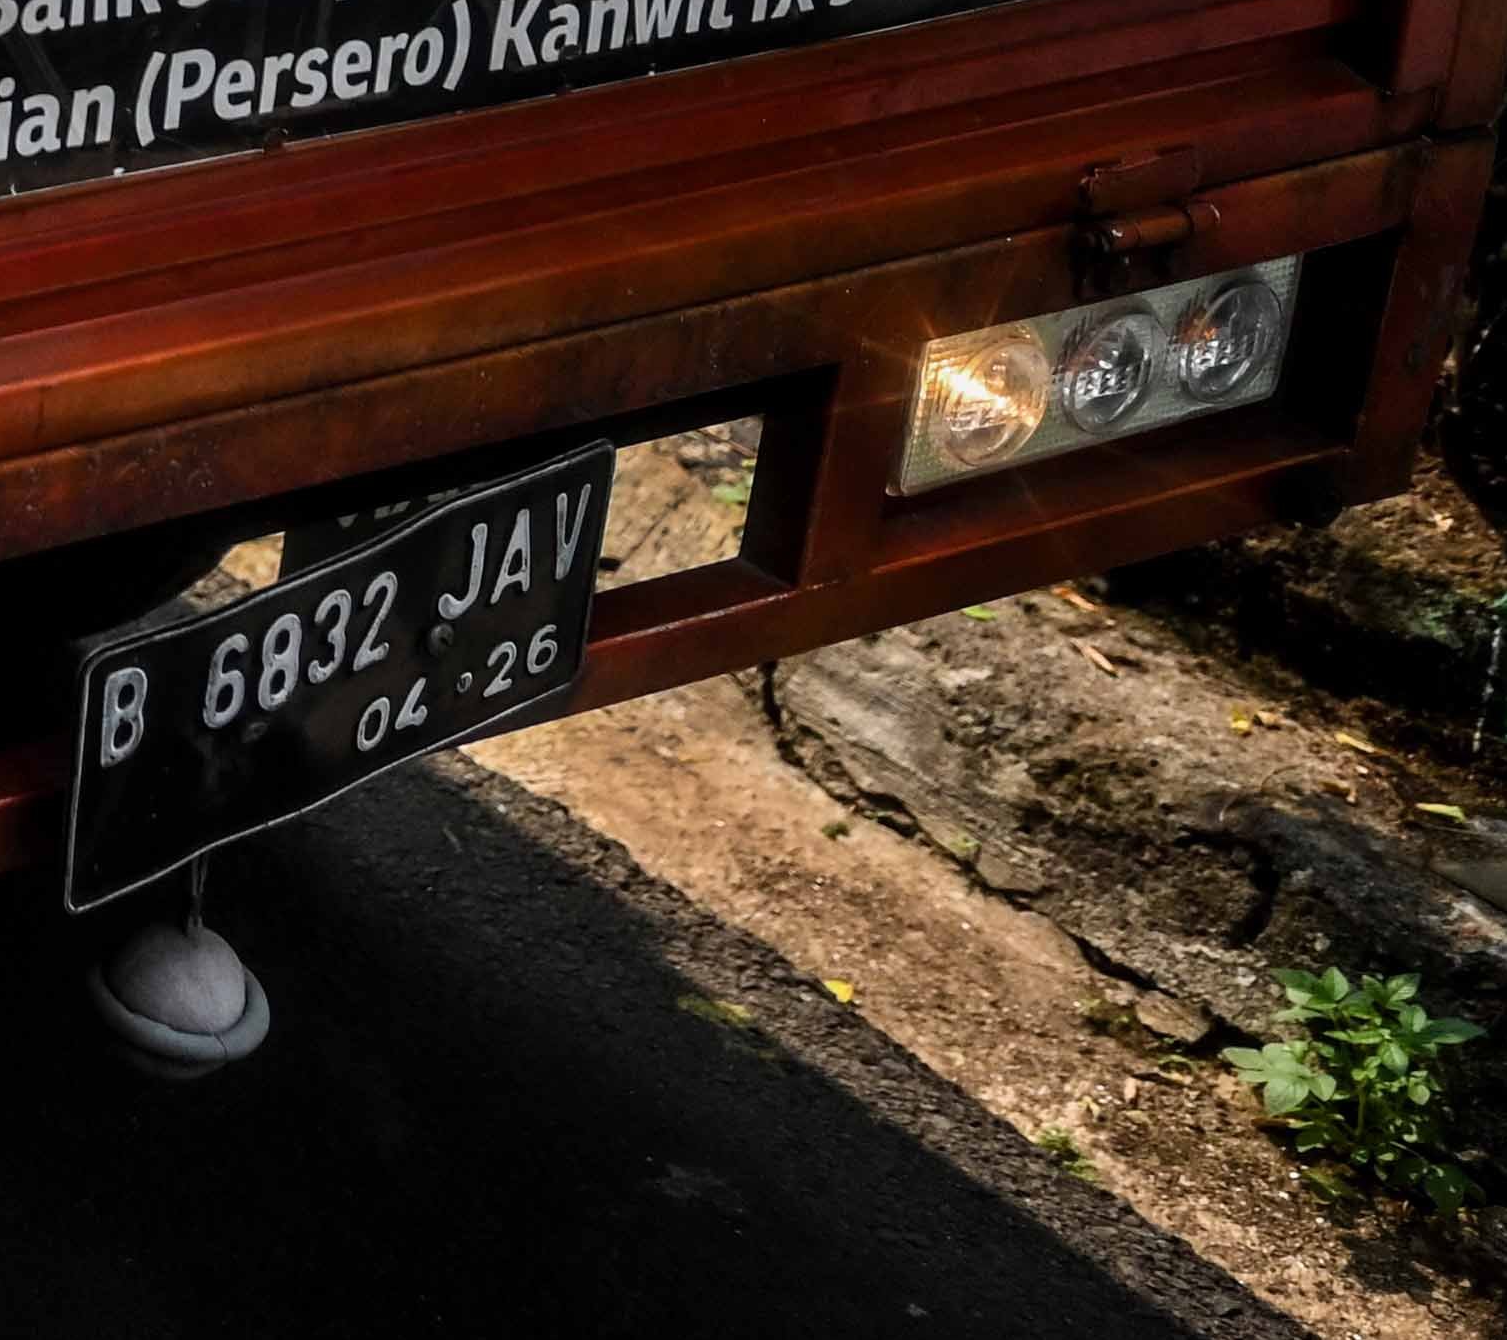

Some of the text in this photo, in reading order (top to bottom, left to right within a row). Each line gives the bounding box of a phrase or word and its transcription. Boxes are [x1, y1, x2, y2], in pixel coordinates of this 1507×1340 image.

[100, 483, 591, 767] B 6832 JAV
